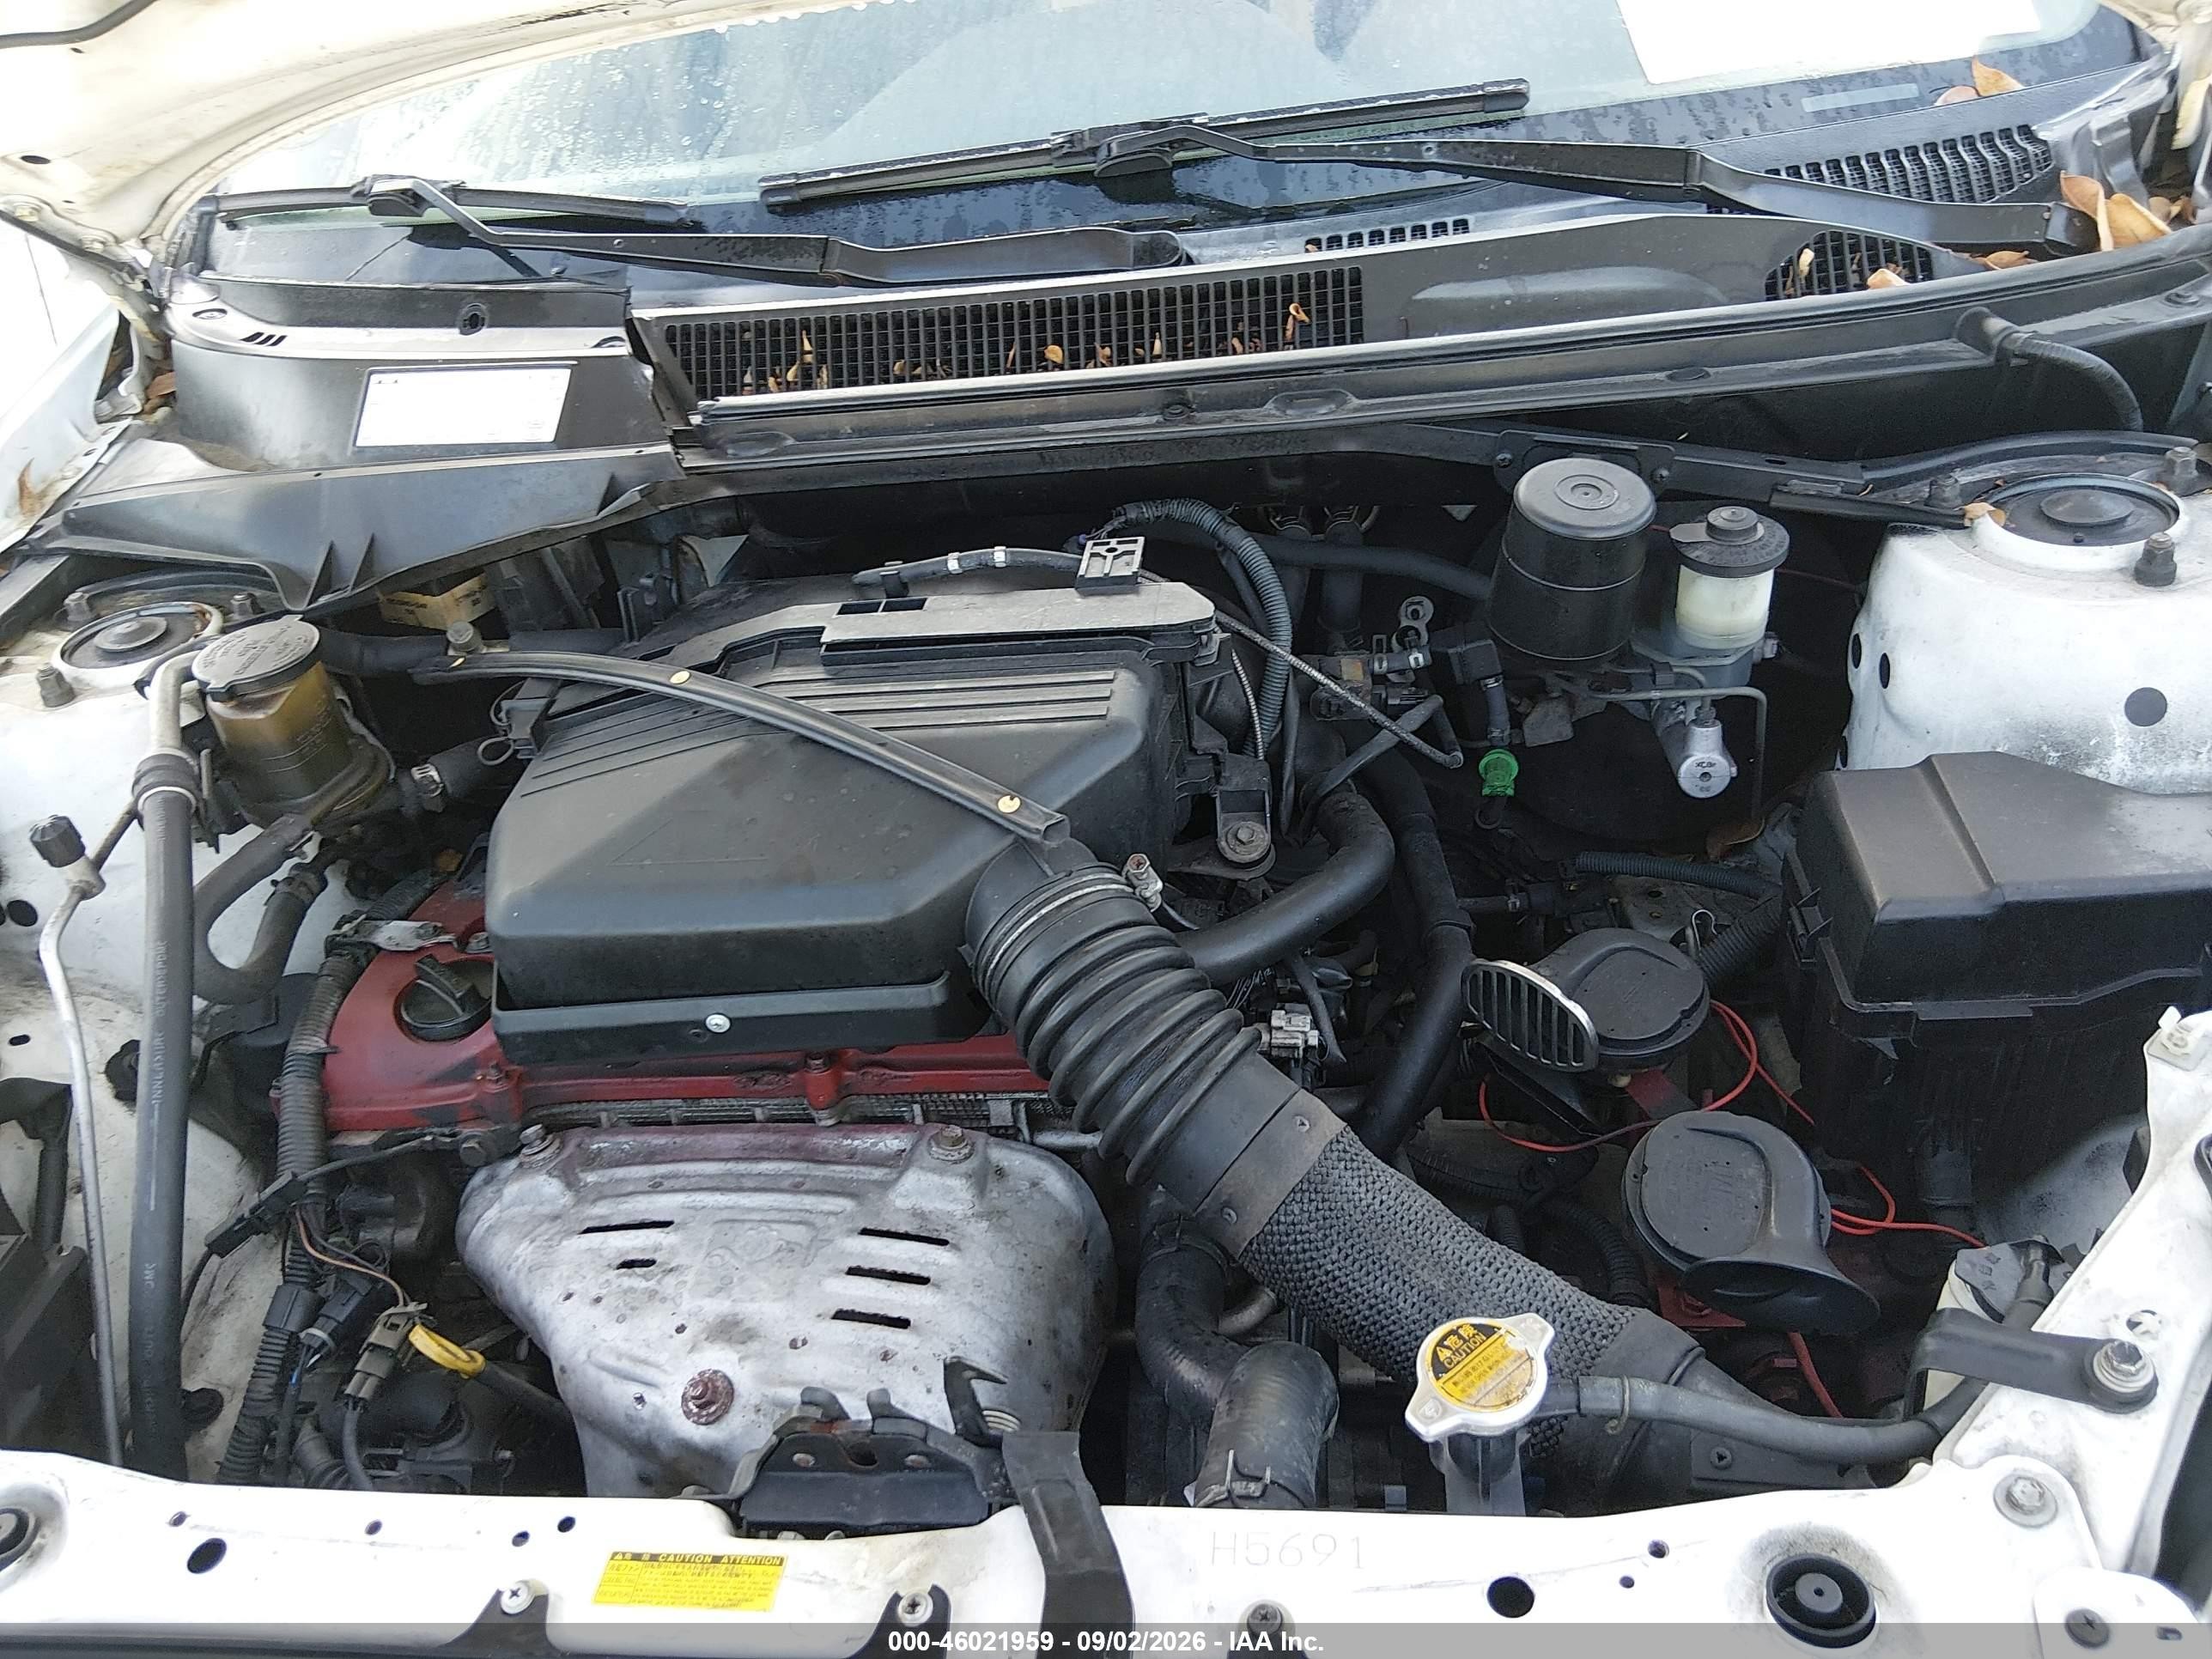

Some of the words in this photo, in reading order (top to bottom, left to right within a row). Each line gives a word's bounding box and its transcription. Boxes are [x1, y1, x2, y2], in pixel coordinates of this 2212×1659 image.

[1443, 1333, 1487, 1369] CAUTION
[658, 1553, 713, 1564] CAUTION
[720, 1555, 781, 1565] ATTENTION
[1211, 1531, 1363, 1569] H5691
